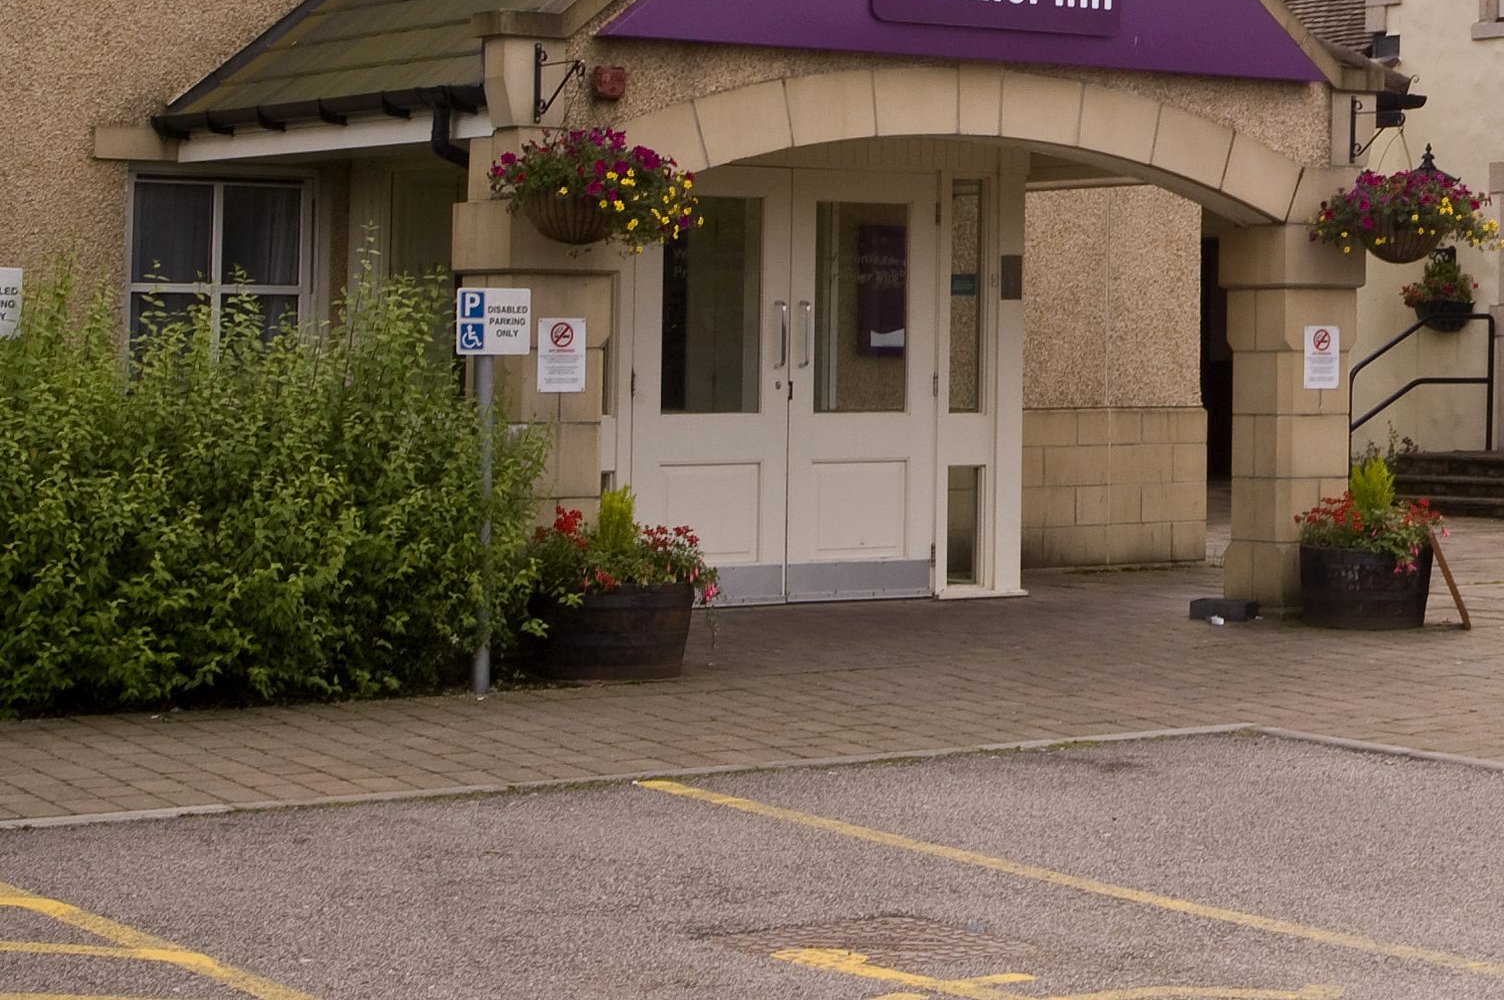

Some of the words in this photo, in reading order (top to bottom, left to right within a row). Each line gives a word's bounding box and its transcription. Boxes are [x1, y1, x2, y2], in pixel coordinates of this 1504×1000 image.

[464, 293, 481, 317] P
[487, 305, 528, 314] DISABLED
[489, 317, 526, 326] PARKING
[496, 329, 518, 338] ONLY
